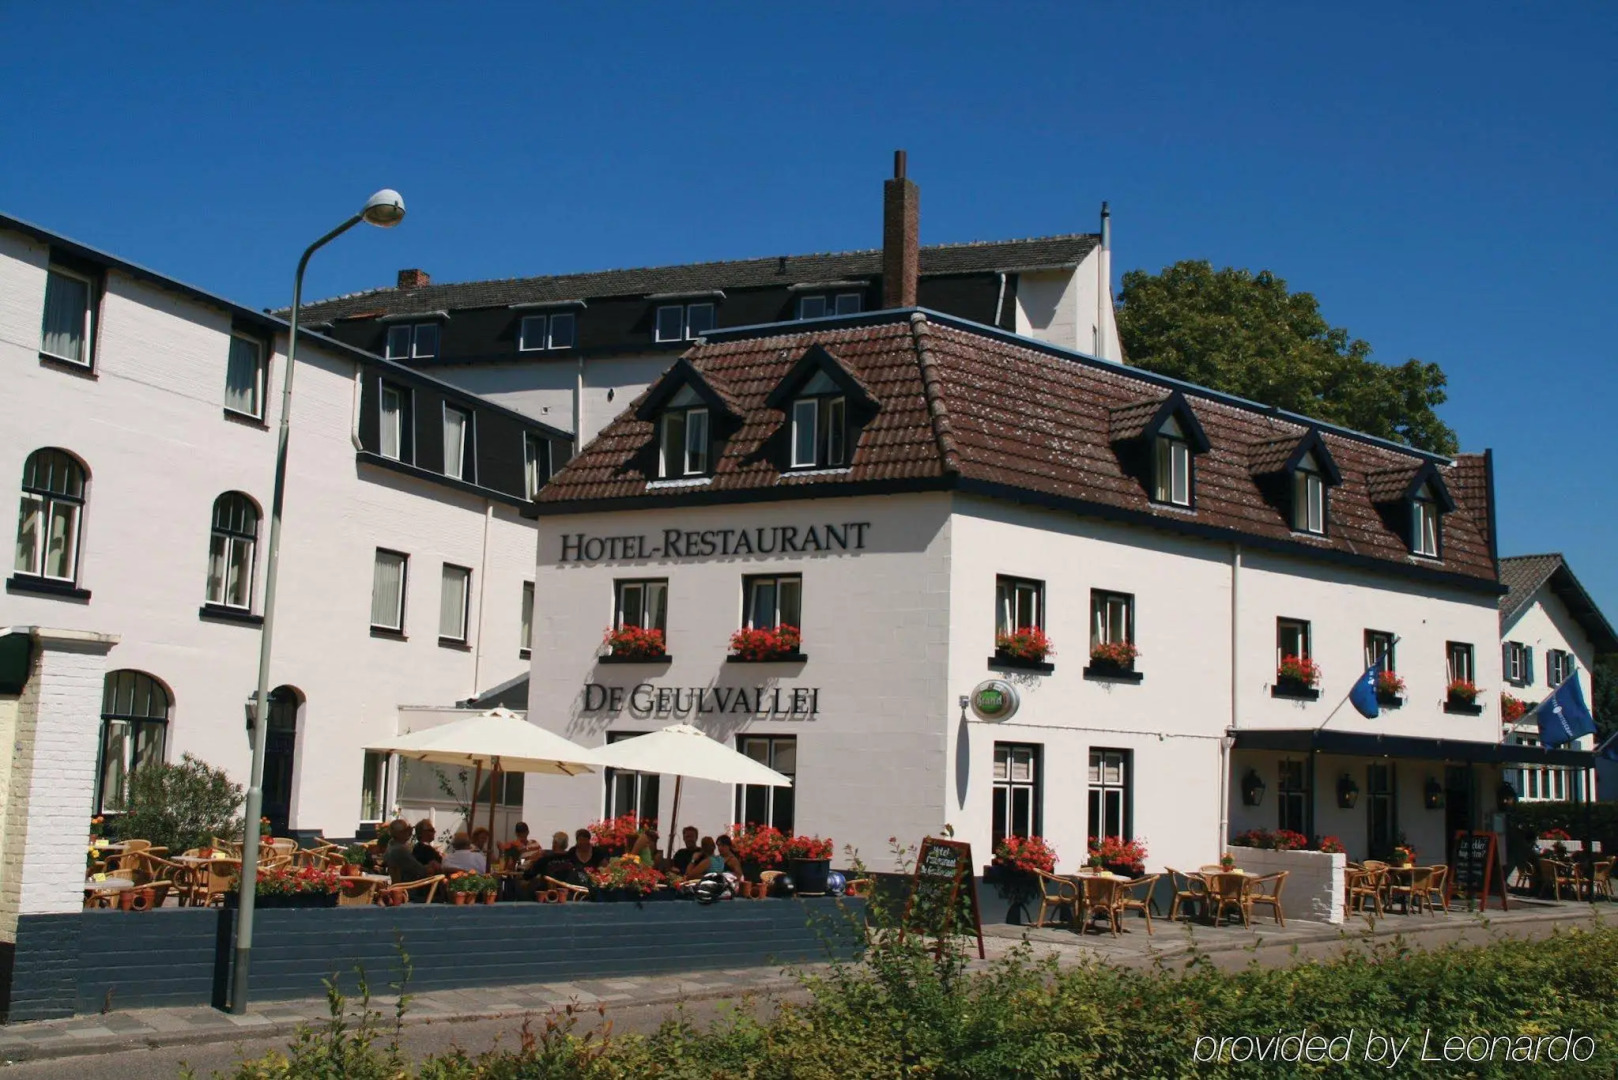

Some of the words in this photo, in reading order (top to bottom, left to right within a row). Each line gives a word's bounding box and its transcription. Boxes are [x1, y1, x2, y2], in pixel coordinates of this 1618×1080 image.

[559, 522, 870, 562] HOTEL-RESTAURANT
[583, 683, 623, 712] DE
[631, 683, 821, 714] GEULVALLEI
